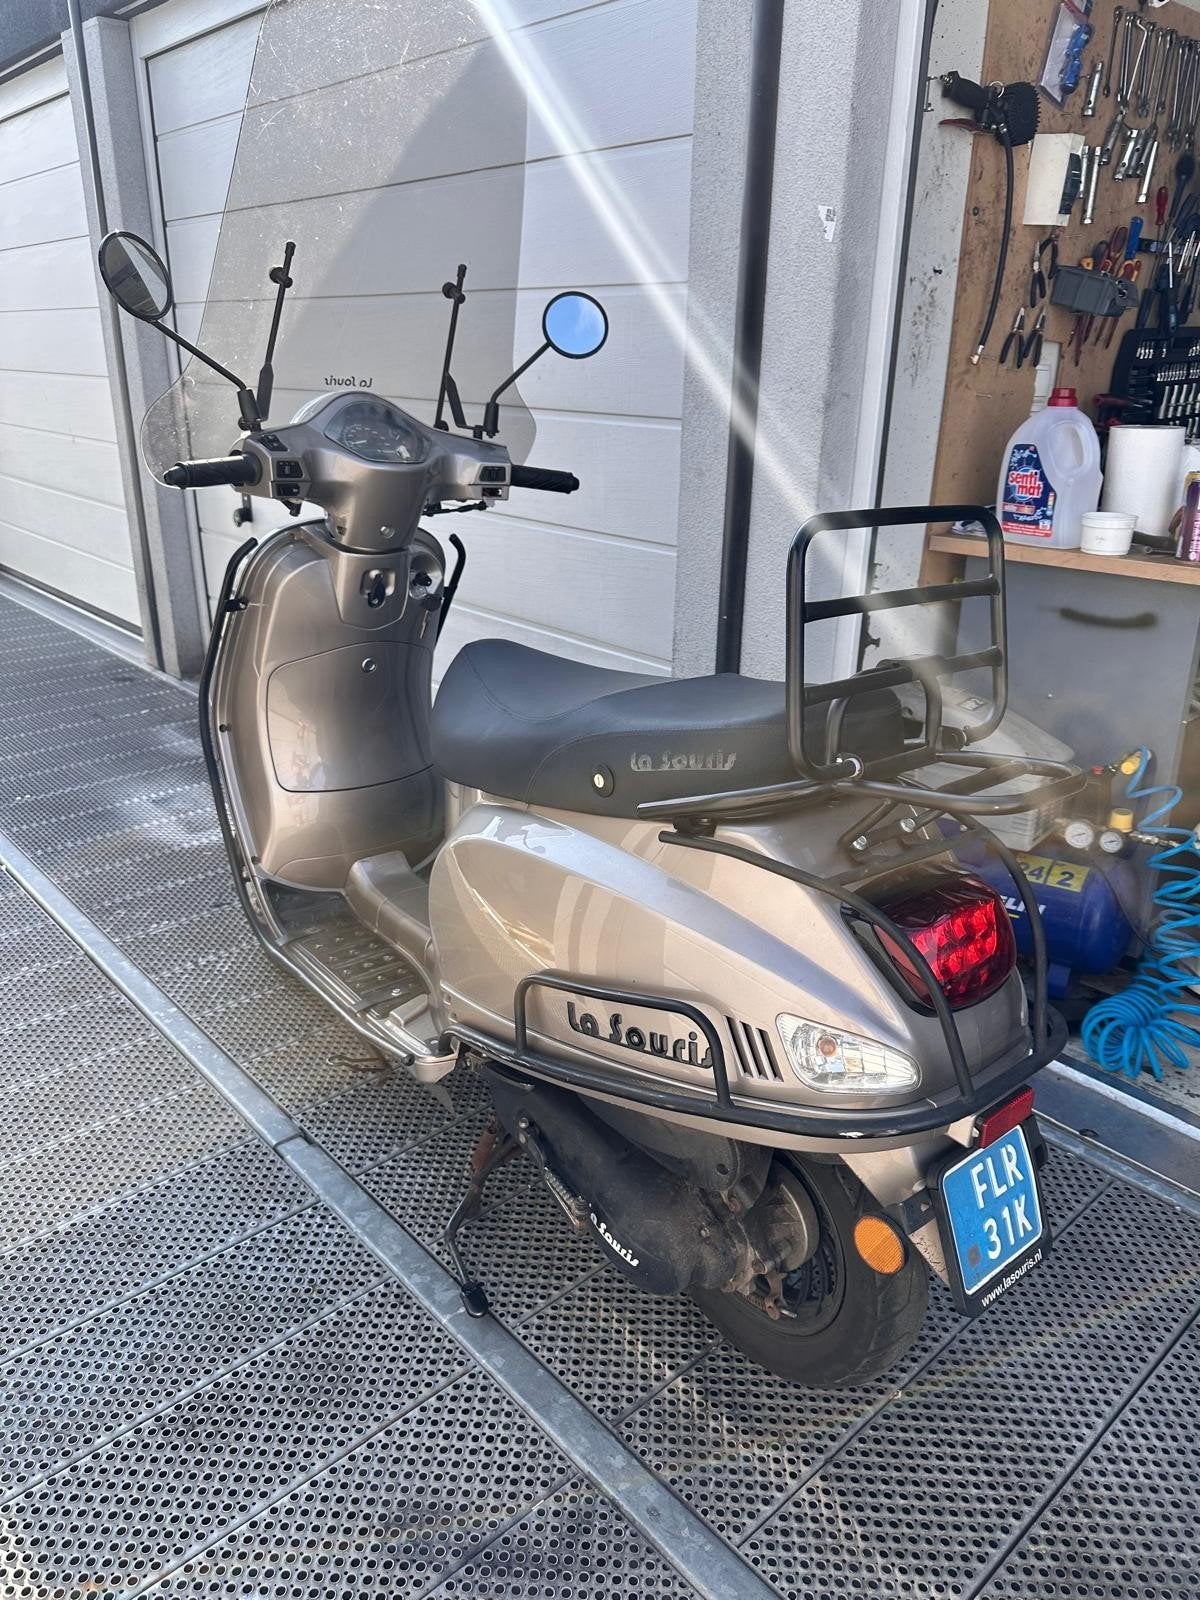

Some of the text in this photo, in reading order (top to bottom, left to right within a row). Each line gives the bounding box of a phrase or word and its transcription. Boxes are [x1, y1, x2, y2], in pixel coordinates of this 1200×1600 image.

[1009, 470, 1038, 486] senti
[1018, 484, 1041, 497] mat
[1055, 870, 1075, 888] 2
[566, 1001, 600, 1036] La
[970, 1143, 1024, 1210] FLR
[599, 1222, 640, 1267] Souris
[982, 1194, 1033, 1260] 31K
[981, 1248, 1043, 1308] www.lasouris.nl
